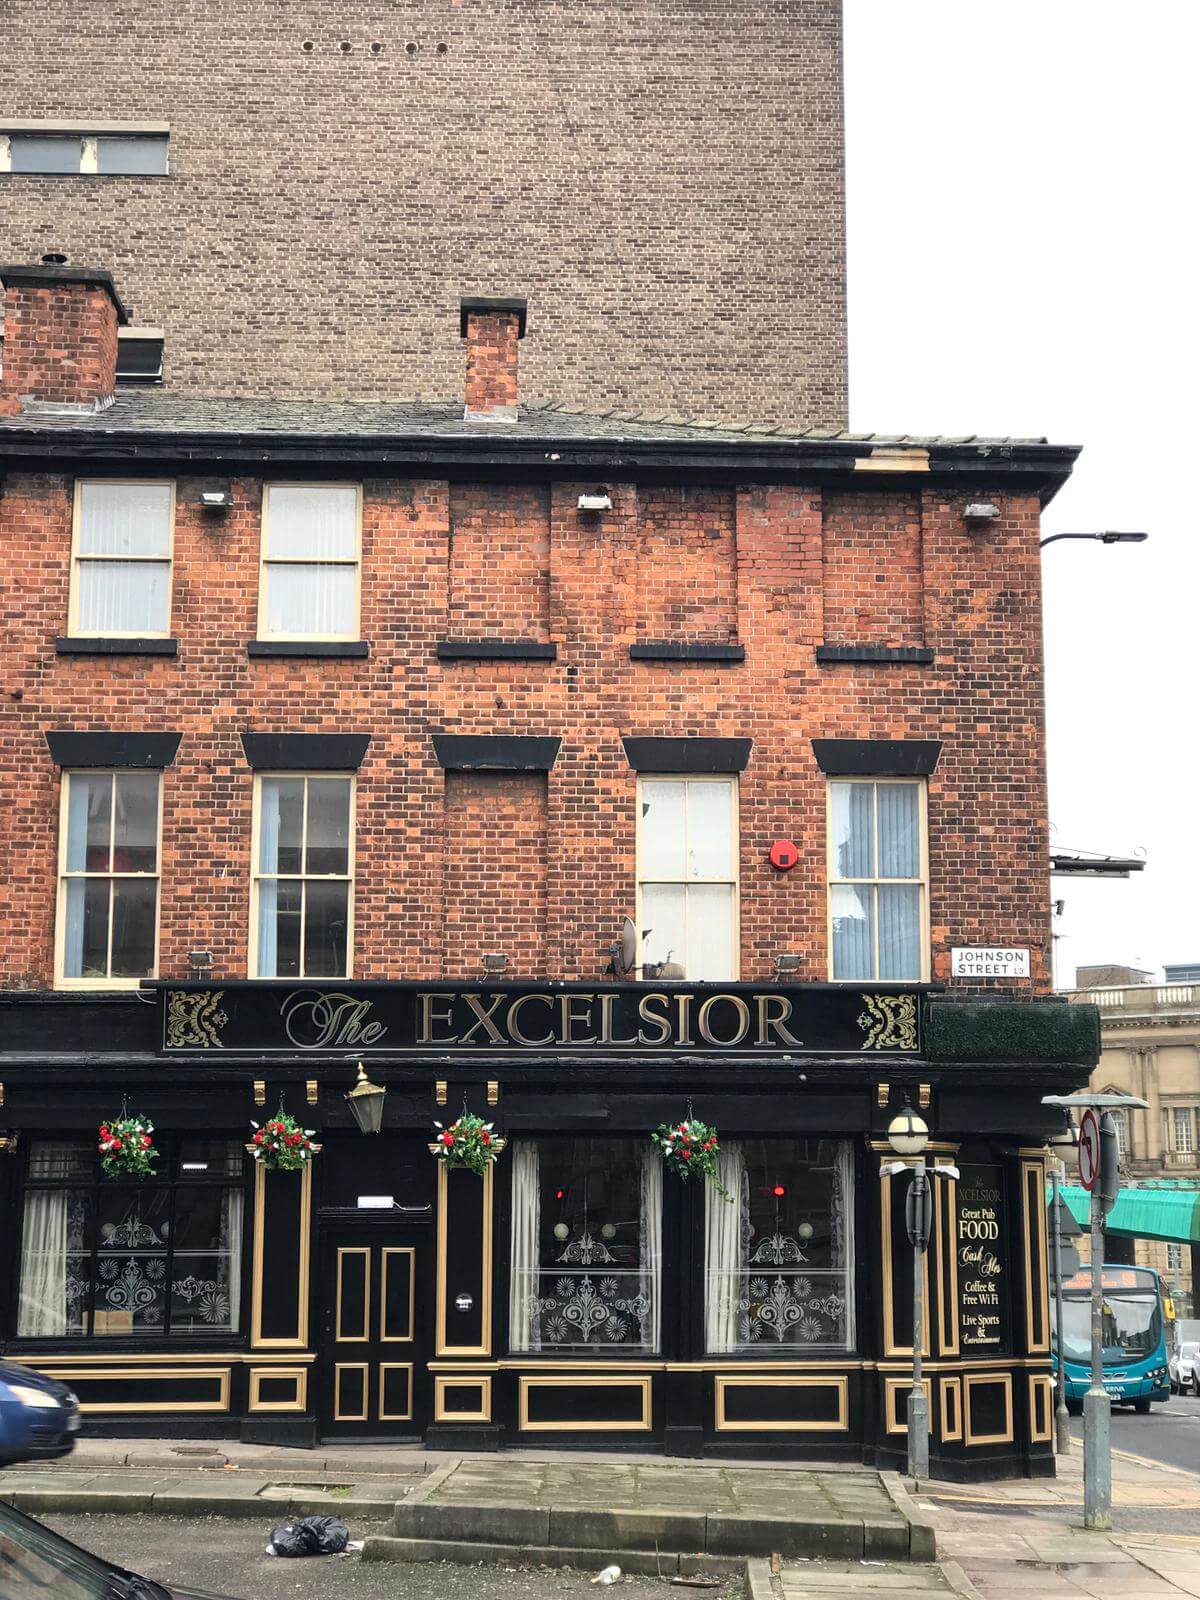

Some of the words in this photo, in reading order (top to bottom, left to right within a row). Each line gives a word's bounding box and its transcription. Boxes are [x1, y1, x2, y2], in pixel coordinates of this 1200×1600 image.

[958, 951, 1024, 962] JOHNSON
[958, 964, 1009, 974] STREET
[1014, 967, 1024, 975] L3
[280, 989, 388, 1048] The
[416, 993, 804, 1046] EXCELSIOR
[959, 1188, 1001, 1202] XCELSIOR
[961, 1207, 980, 1219] Great
[982, 1207, 995, 1219] Pub
[960, 1220, 999, 1240] FOOD
[965, 1280, 987, 1292] Coffee
[988, 1281, 996, 1292] &
[962, 1294, 978, 1305] Free
[978, 1294, 991, 1305] Wi
[991, 1294, 999, 1305] Fi
[962, 1314, 977, 1326] Live
[977, 1314, 1000, 1329] Sports
[977, 1327, 986, 1338] &
